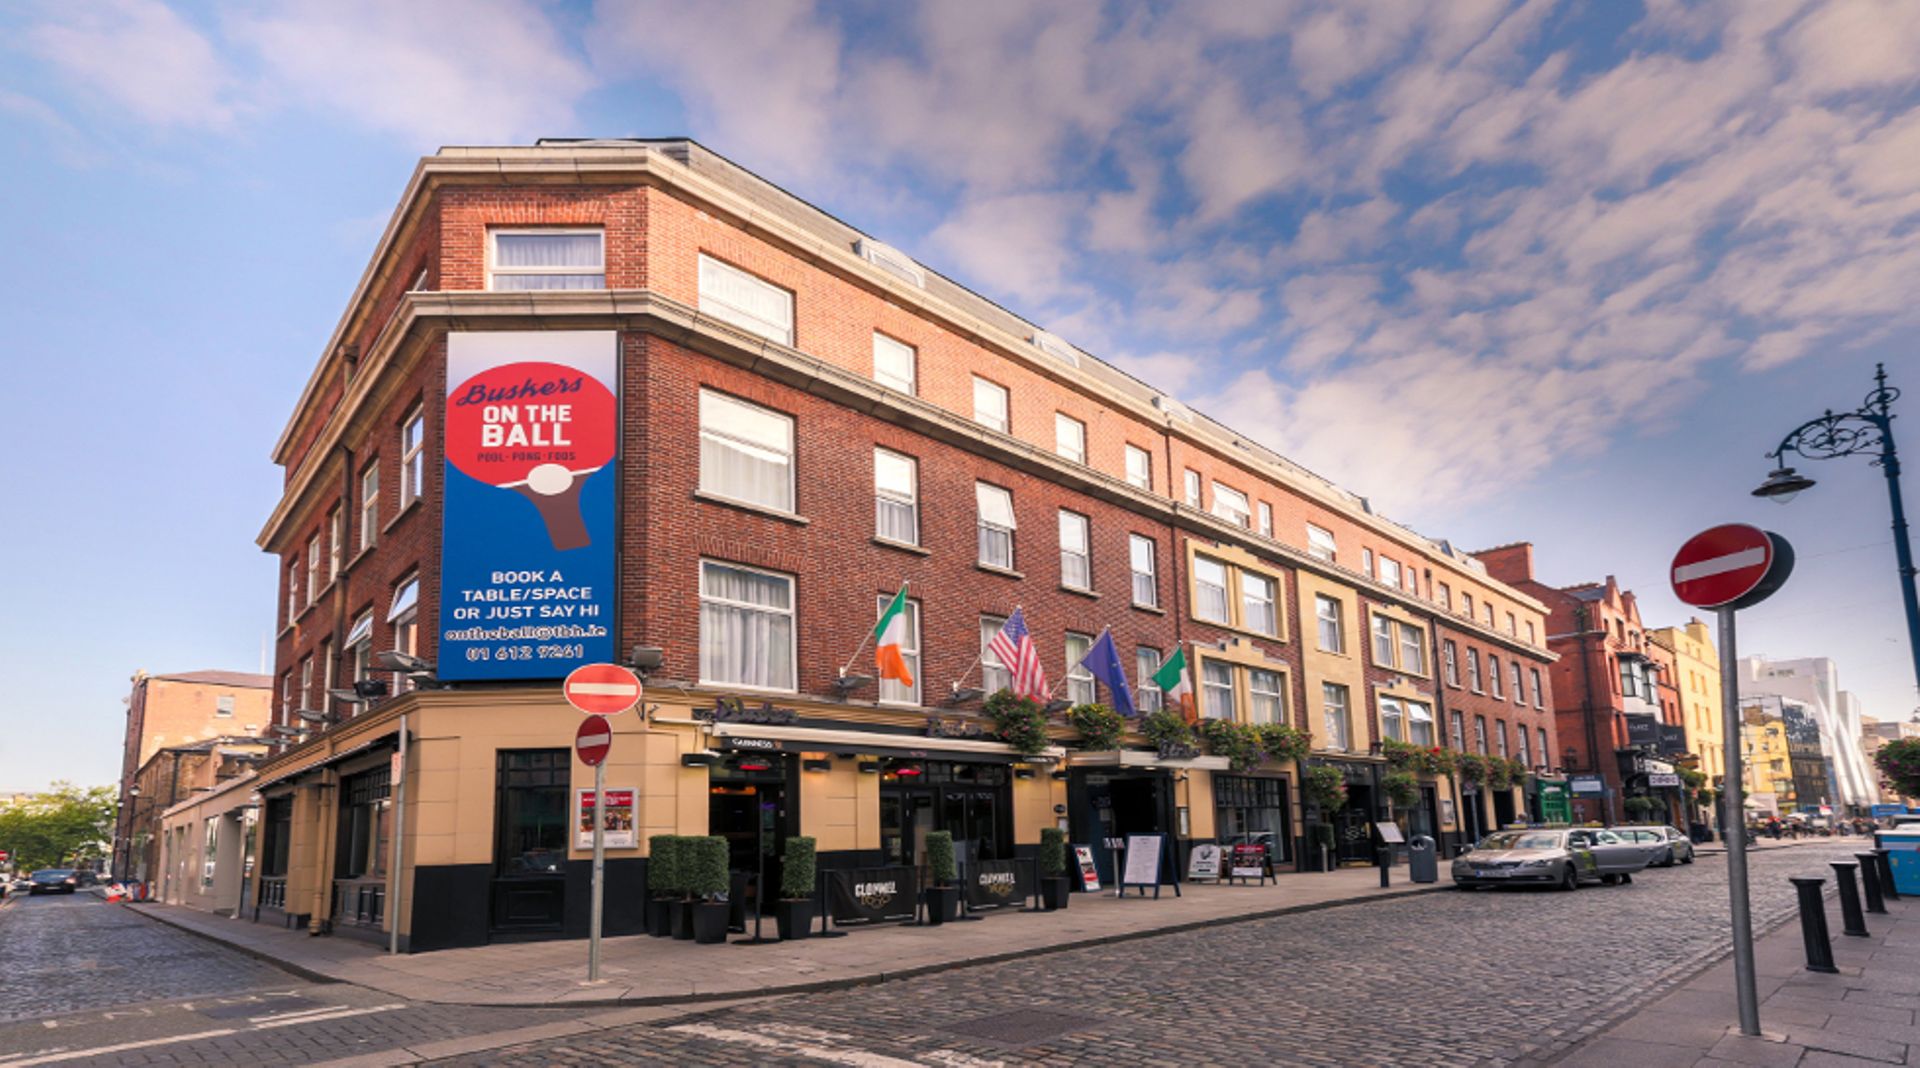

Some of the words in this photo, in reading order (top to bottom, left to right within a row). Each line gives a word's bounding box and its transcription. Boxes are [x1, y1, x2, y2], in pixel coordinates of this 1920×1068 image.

[456, 377, 583, 406] Buskers
[483, 405, 518, 424] ON
[525, 404, 572, 422] THE
[481, 423, 572, 447] BALL
[477, 453, 504, 462] POOL
[512, 452, 541, 461] PONG
[491, 571, 545, 584] BOOK
[549, 570, 563, 582] A
[462, 587, 592, 602] TABLE/SPACE
[453, 608, 480, 620] OR
[485, 606, 534, 620] JUST
[539, 605, 576, 618] SAY
[579, 604, 599, 617] HI
[495, 646, 532, 660] 612
[537, 644, 584, 659] 9261
